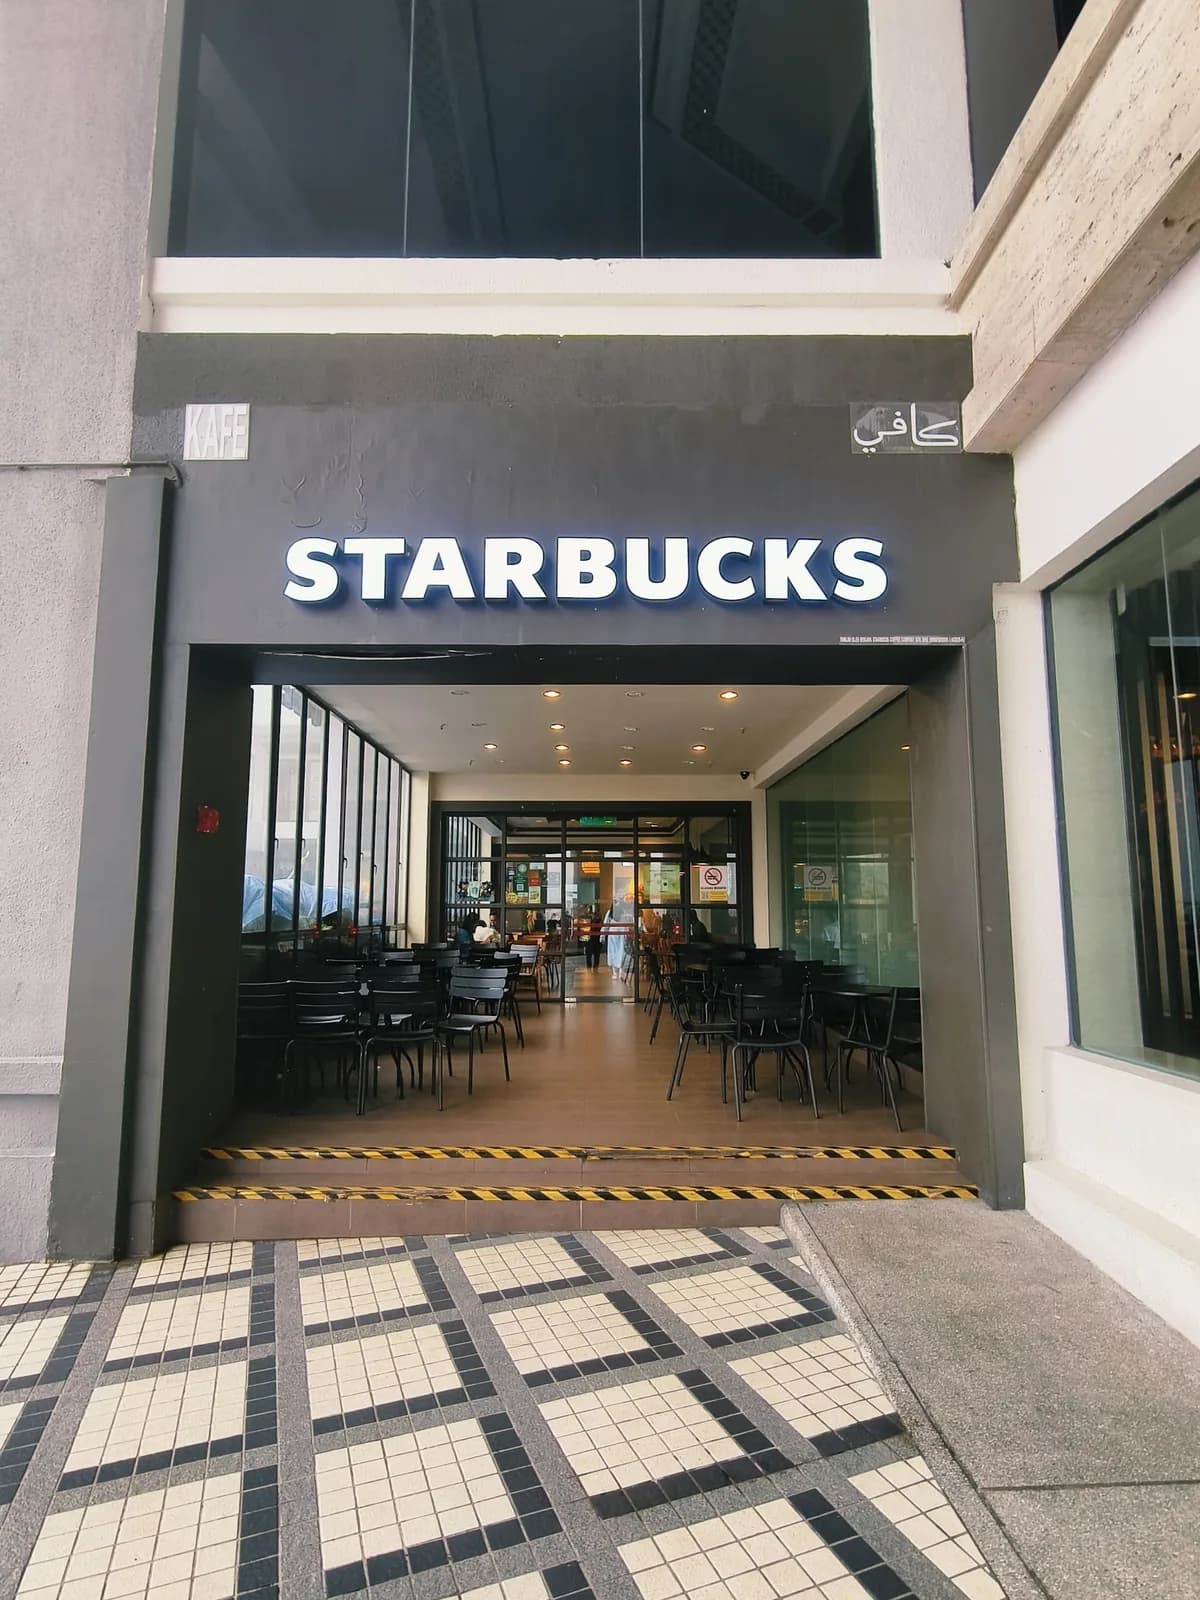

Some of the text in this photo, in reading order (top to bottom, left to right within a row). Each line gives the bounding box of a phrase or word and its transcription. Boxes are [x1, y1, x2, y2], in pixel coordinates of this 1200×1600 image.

[184, 404, 249, 460] KAFE
[853, 402, 959, 454] كافي
[284, 536, 889, 603] STARBUCKS
